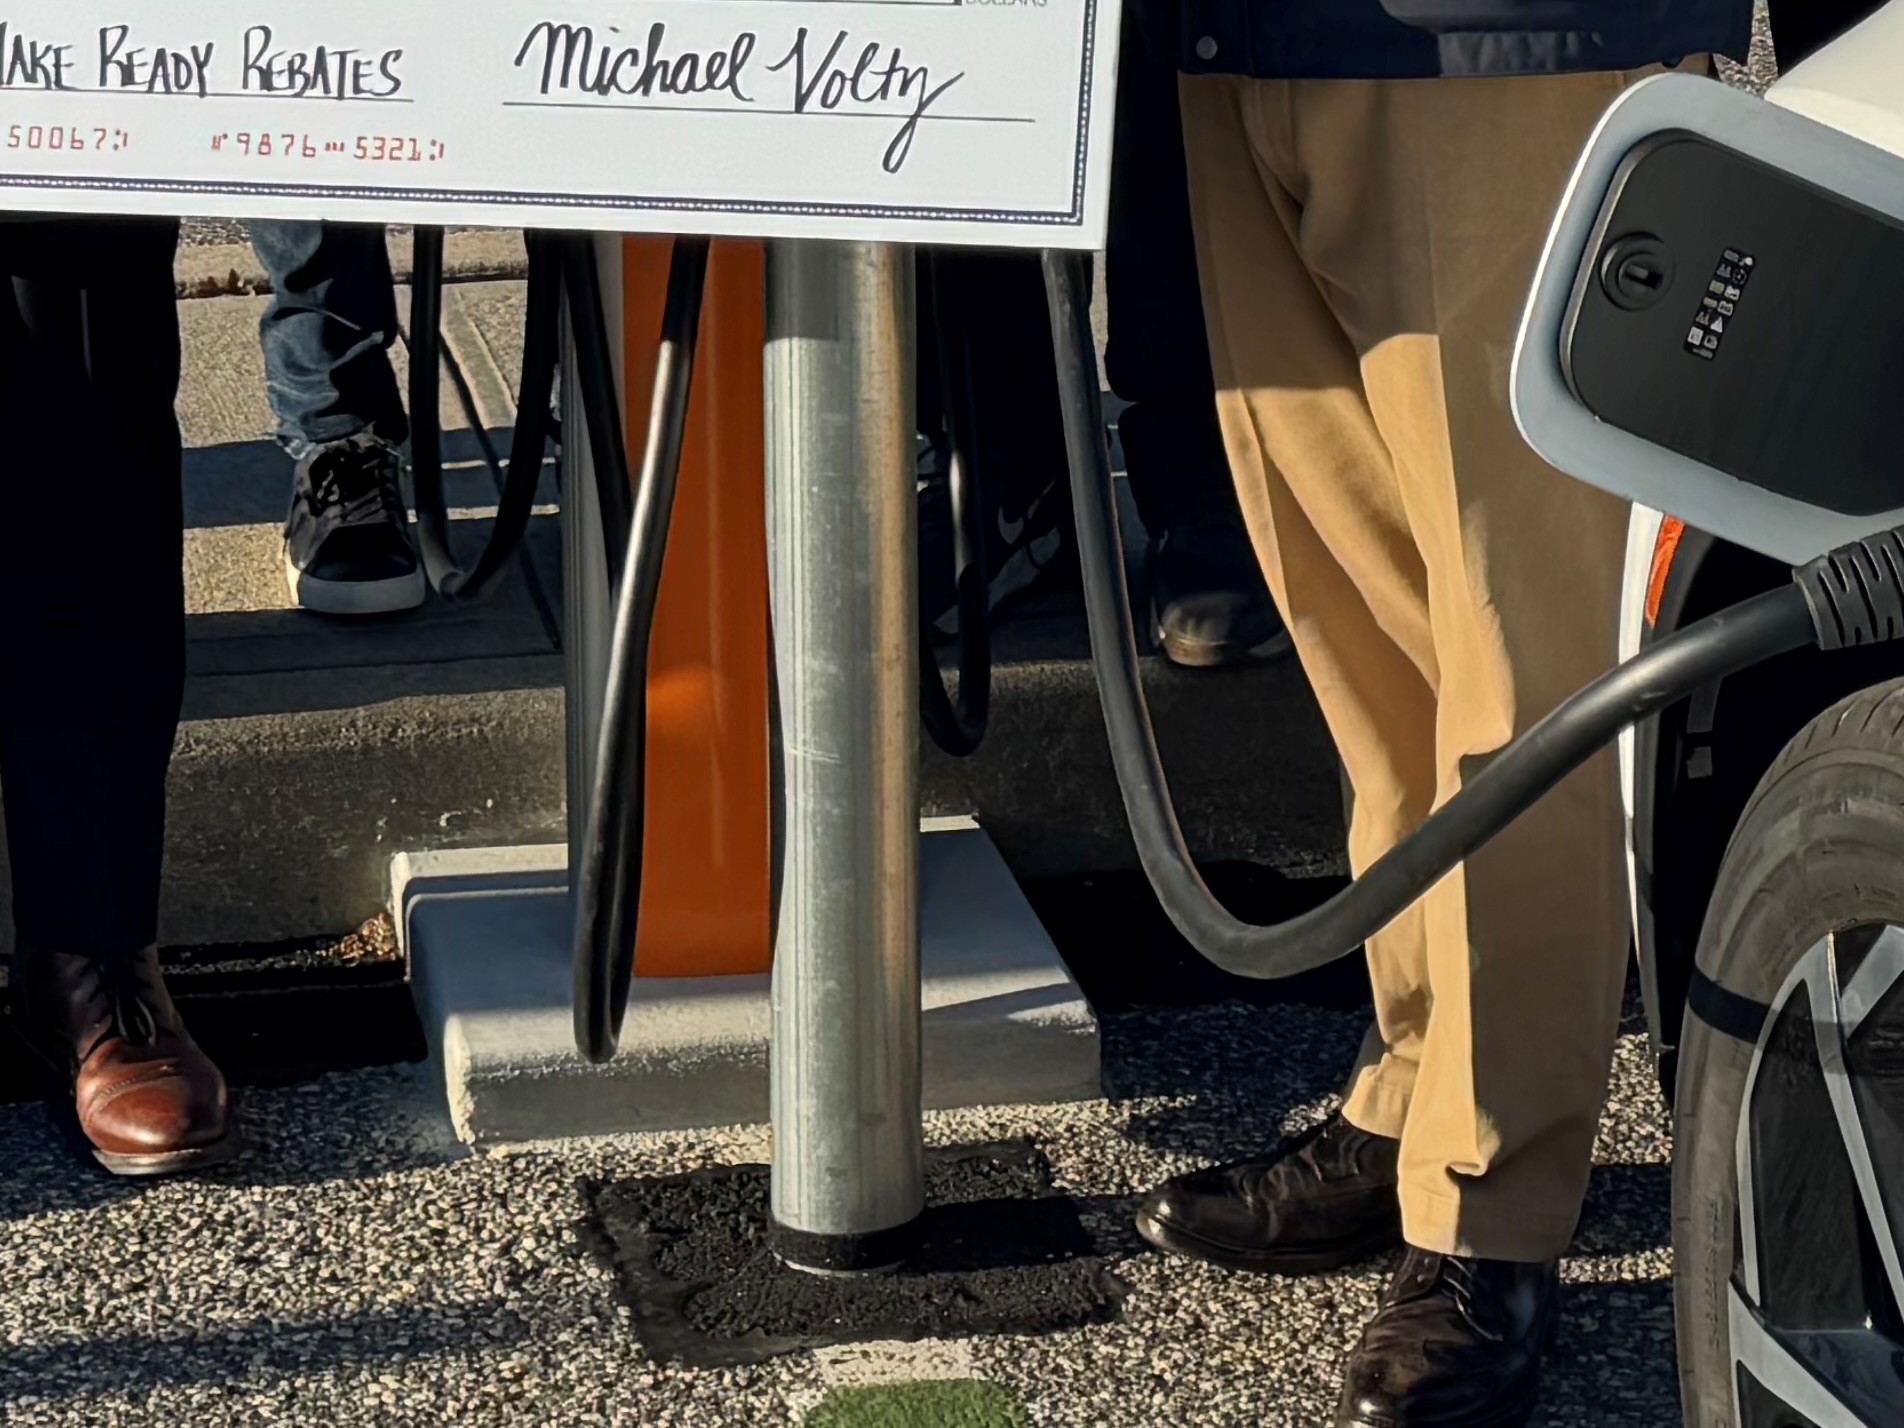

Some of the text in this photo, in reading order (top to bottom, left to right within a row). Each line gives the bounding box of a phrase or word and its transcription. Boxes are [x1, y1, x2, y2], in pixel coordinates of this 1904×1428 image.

[99, 24, 215, 98] READY
[241, 24, 402, 100] REBATES
[514, 21, 757, 103] Michael
